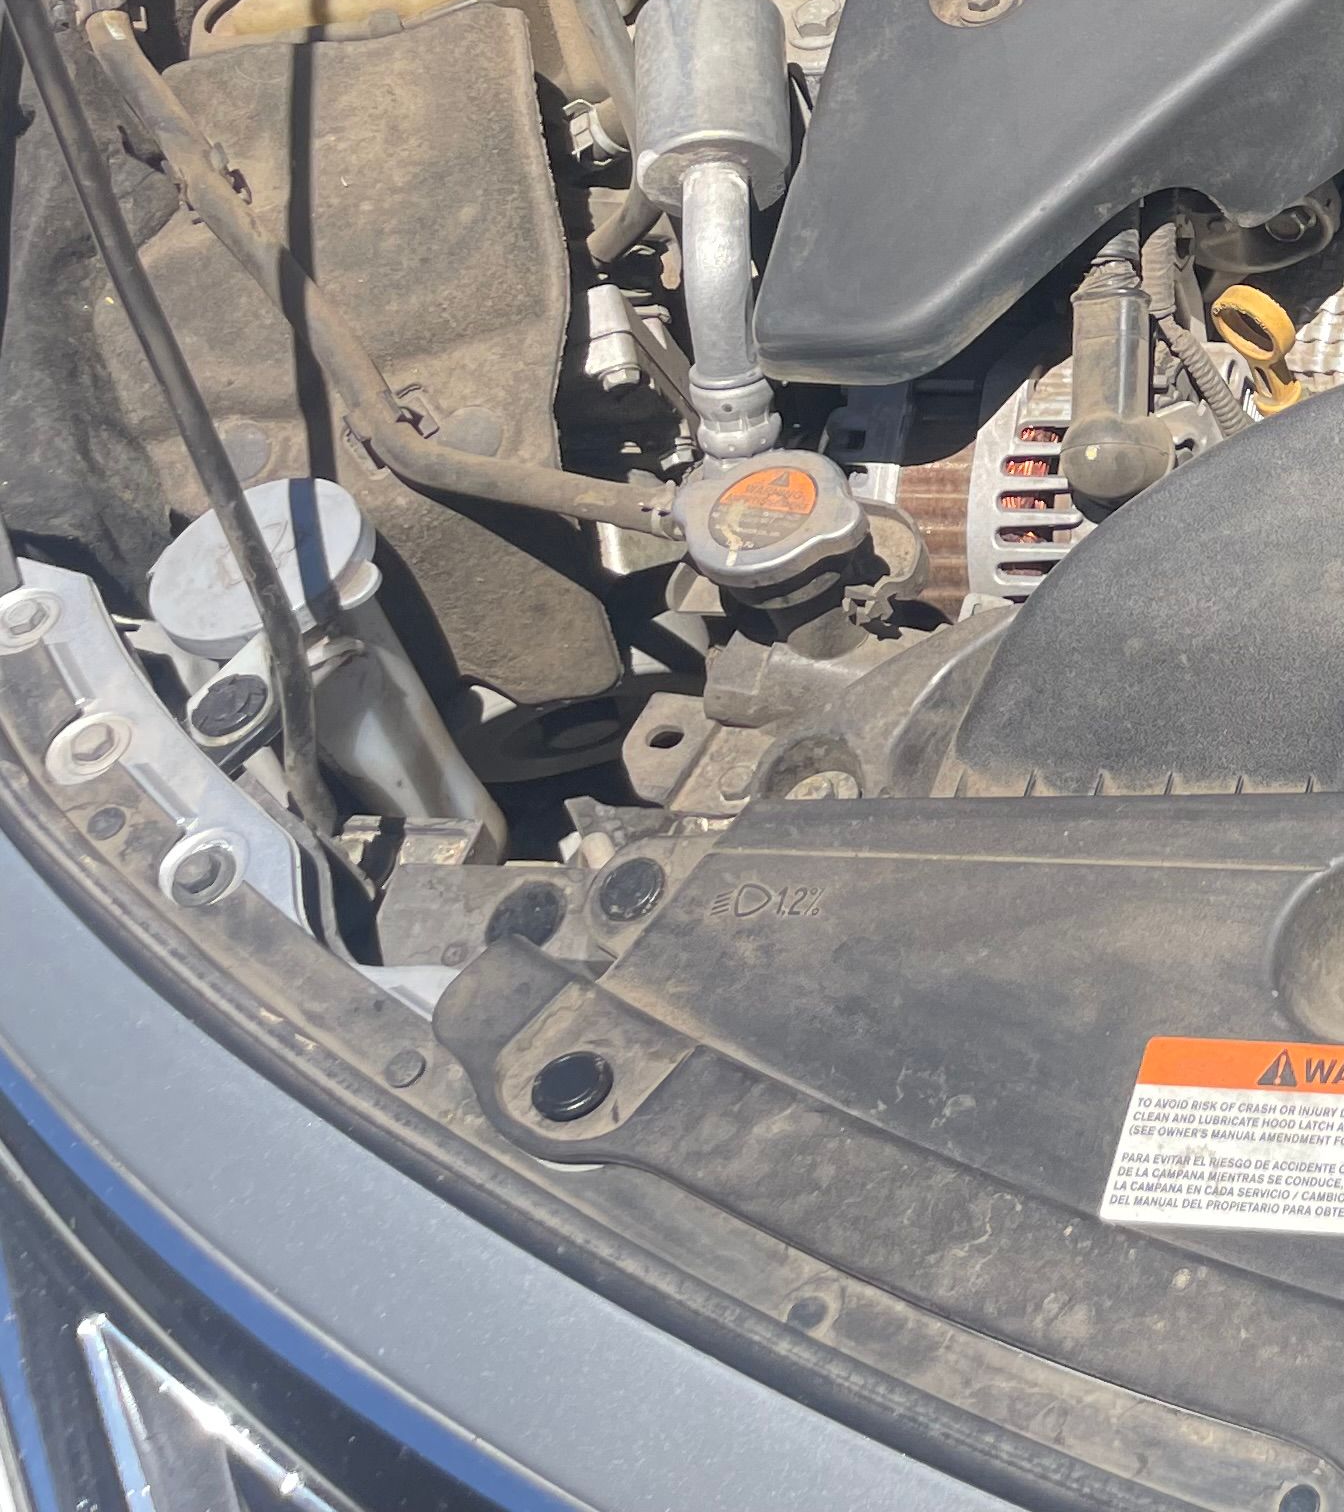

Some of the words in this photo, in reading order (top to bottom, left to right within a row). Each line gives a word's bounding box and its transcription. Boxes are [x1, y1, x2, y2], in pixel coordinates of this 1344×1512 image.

[1138, 1097, 1152, 1108] TO
[1154, 1099, 1189, 1110] AVOID
[1191, 1100, 1217, 1112] RISK
[1220, 1102, 1237, 1113] OF
[1238, 1103, 1276, 1115] CRASH
[1280, 1105, 1296, 1115] OR
[1298, 1106, 1337, 1118] INJURY
[1133, 1111, 1170, 1123] CLEAN
[1171, 1113, 1196, 1124] AND
[1198, 1115, 1259, 1128] LUBRICATE
[1262, 1118, 1296, 1129] HOOD
[1298, 1120, 1334, 1132] LATCH
[1129, 1124, 1155, 1137] (SEE
[1158, 1126, 1208, 1139] OWNER'S
[1211, 1129, 1257, 1142] MANUAL
[1259, 1132, 1331, 1146] AMENDMENT
[1121, 1151, 1150, 1164] PARA
[1153, 1154, 1191, 1166] EVITAR
[1193, 1156, 1206, 1167] EL
[1209, 1157, 1252, 1170] RIESGO
[1254, 1159, 1270, 1170] DE
[1272, 1161, 1336, 1174] ACCIDENTE
[1117, 1166, 1134, 1177] DE
[1135, 1168, 1150, 1178] LA
[1152, 1169, 1205, 1181] CAMPANA
[1207, 1172, 1265, 1185] MIENTRAS
[1267, 1174, 1282, 1185] SE
[1285, 1176, 1344, 1189] CONDUCE,
[1113, 1181, 1127, 1191] LA
[1130, 1181, 1184, 1194] CAMPANA
[1186, 1185, 1202, 1195] EN
[1204, 1186, 1234, 1197] CADA
[1237, 1188, 1291, 1200] SERVICIO
[1109, 1194, 1131, 1206] DEL
[1133, 1196, 1179, 1209] MANUAL
[1182, 1199, 1203, 1210] DEL
[1206, 1200, 1280, 1214] PROPIETARIO
[1282, 1204, 1312, 1216] PARA
